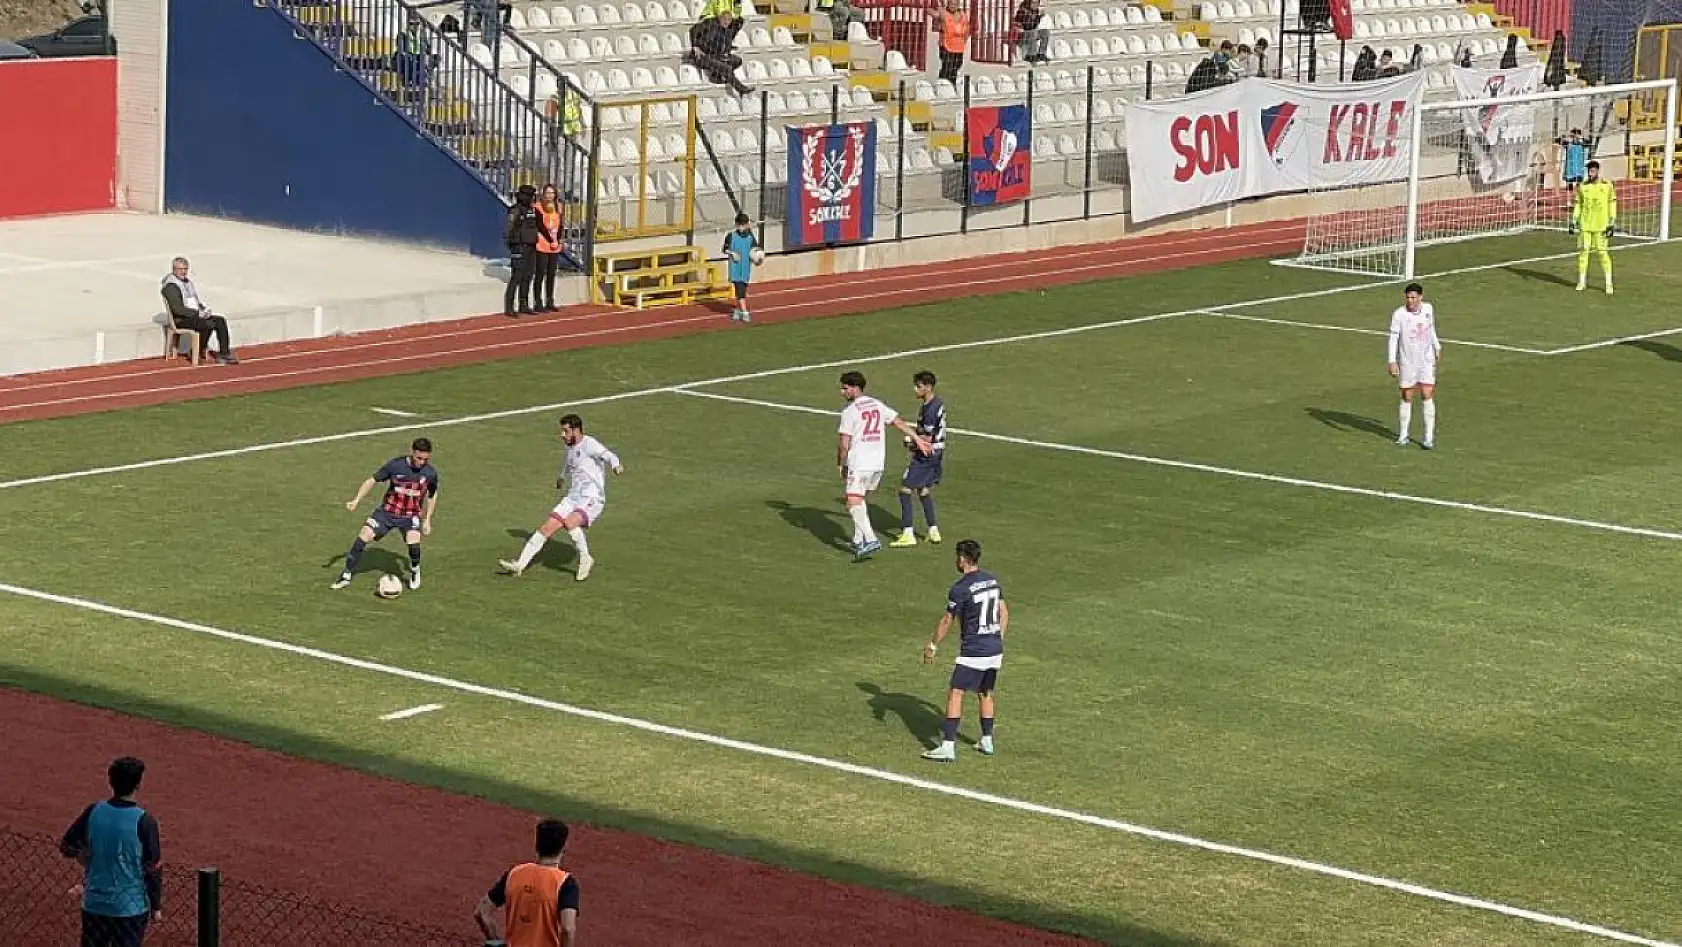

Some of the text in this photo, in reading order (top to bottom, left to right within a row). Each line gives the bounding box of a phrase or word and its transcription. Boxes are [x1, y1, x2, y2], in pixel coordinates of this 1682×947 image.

[1170, 109, 1240, 182] SON
[1323, 101, 1407, 164] KALE
[861, 409, 881, 436] 22
[973, 588, 1000, 627] 77
